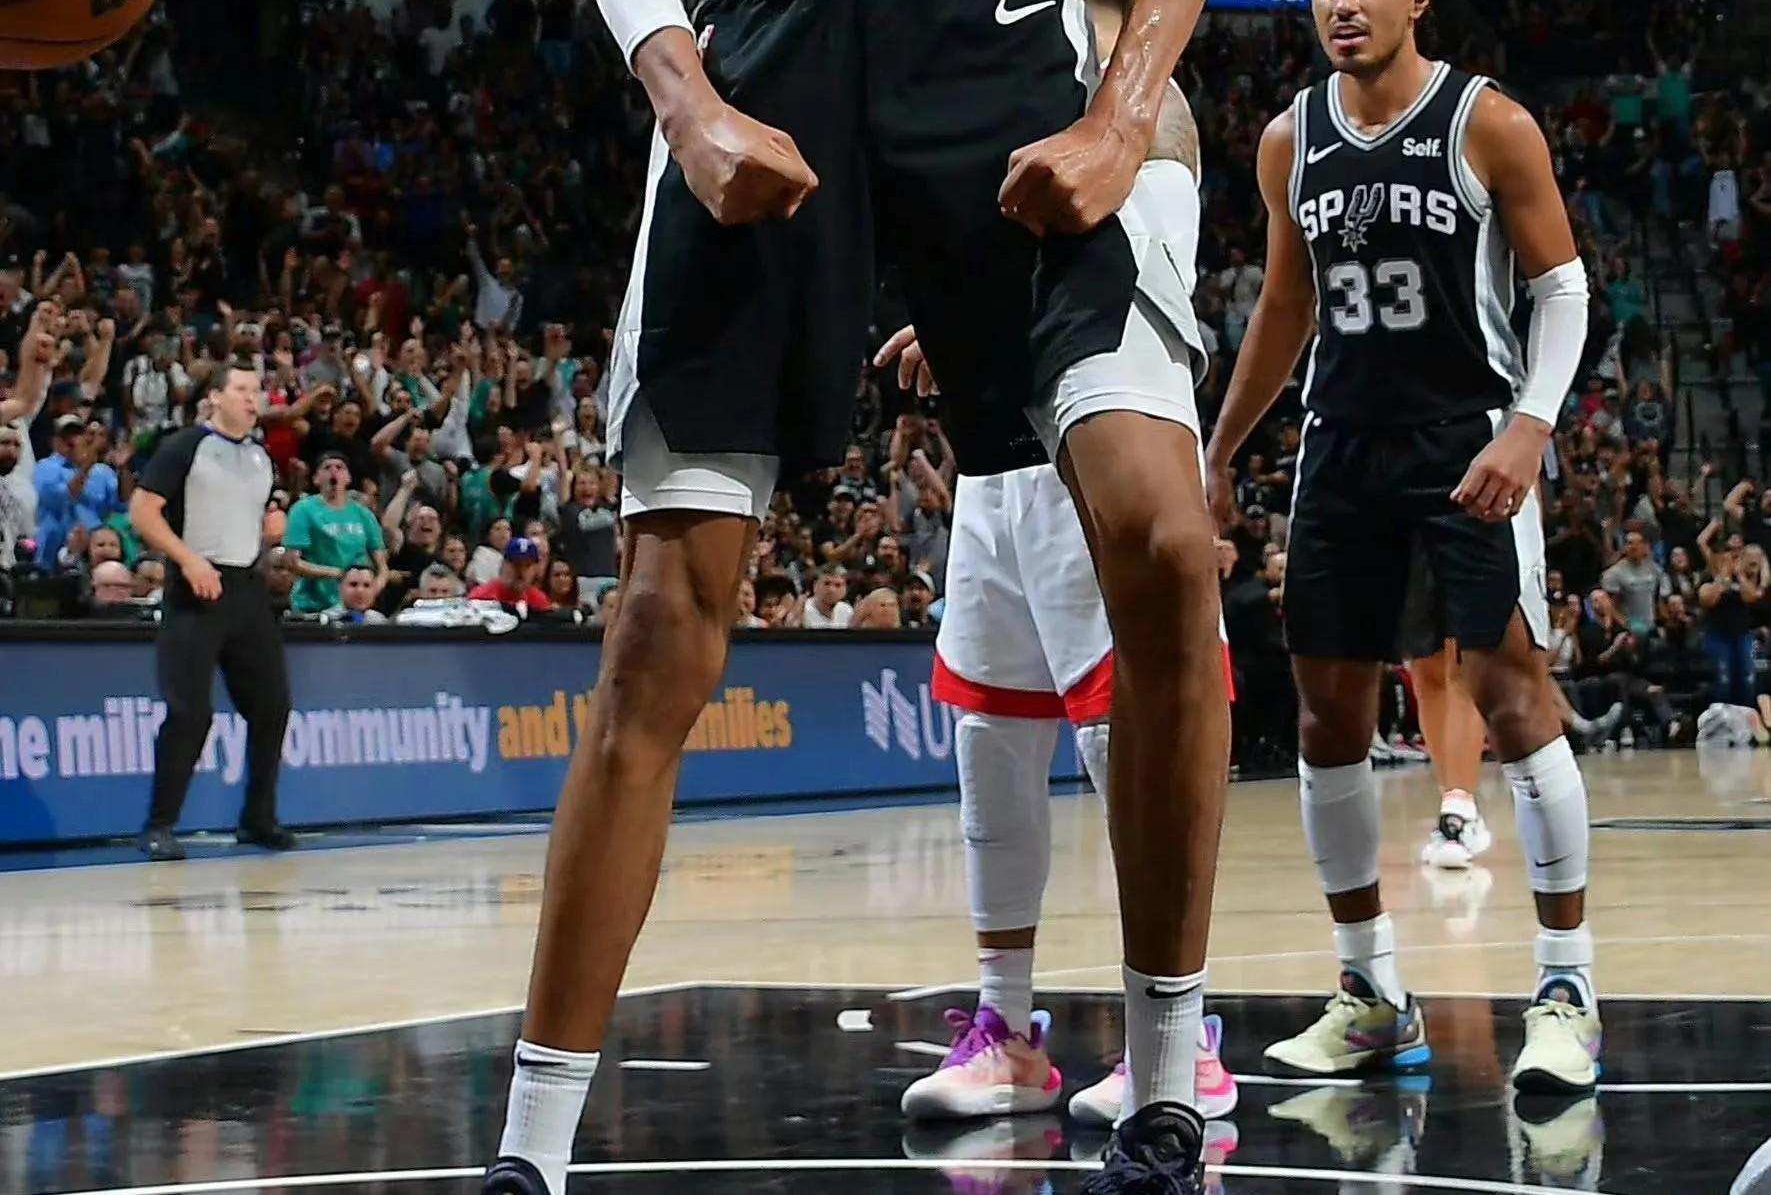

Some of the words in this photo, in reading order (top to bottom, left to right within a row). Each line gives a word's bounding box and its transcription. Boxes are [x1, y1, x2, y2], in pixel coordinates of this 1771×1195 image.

[1298, 183, 1458, 253] SPURS
[1325, 260, 1427, 336] 33
[283, 691, 490, 773] ommunity
[498, 691, 571, 759] and
